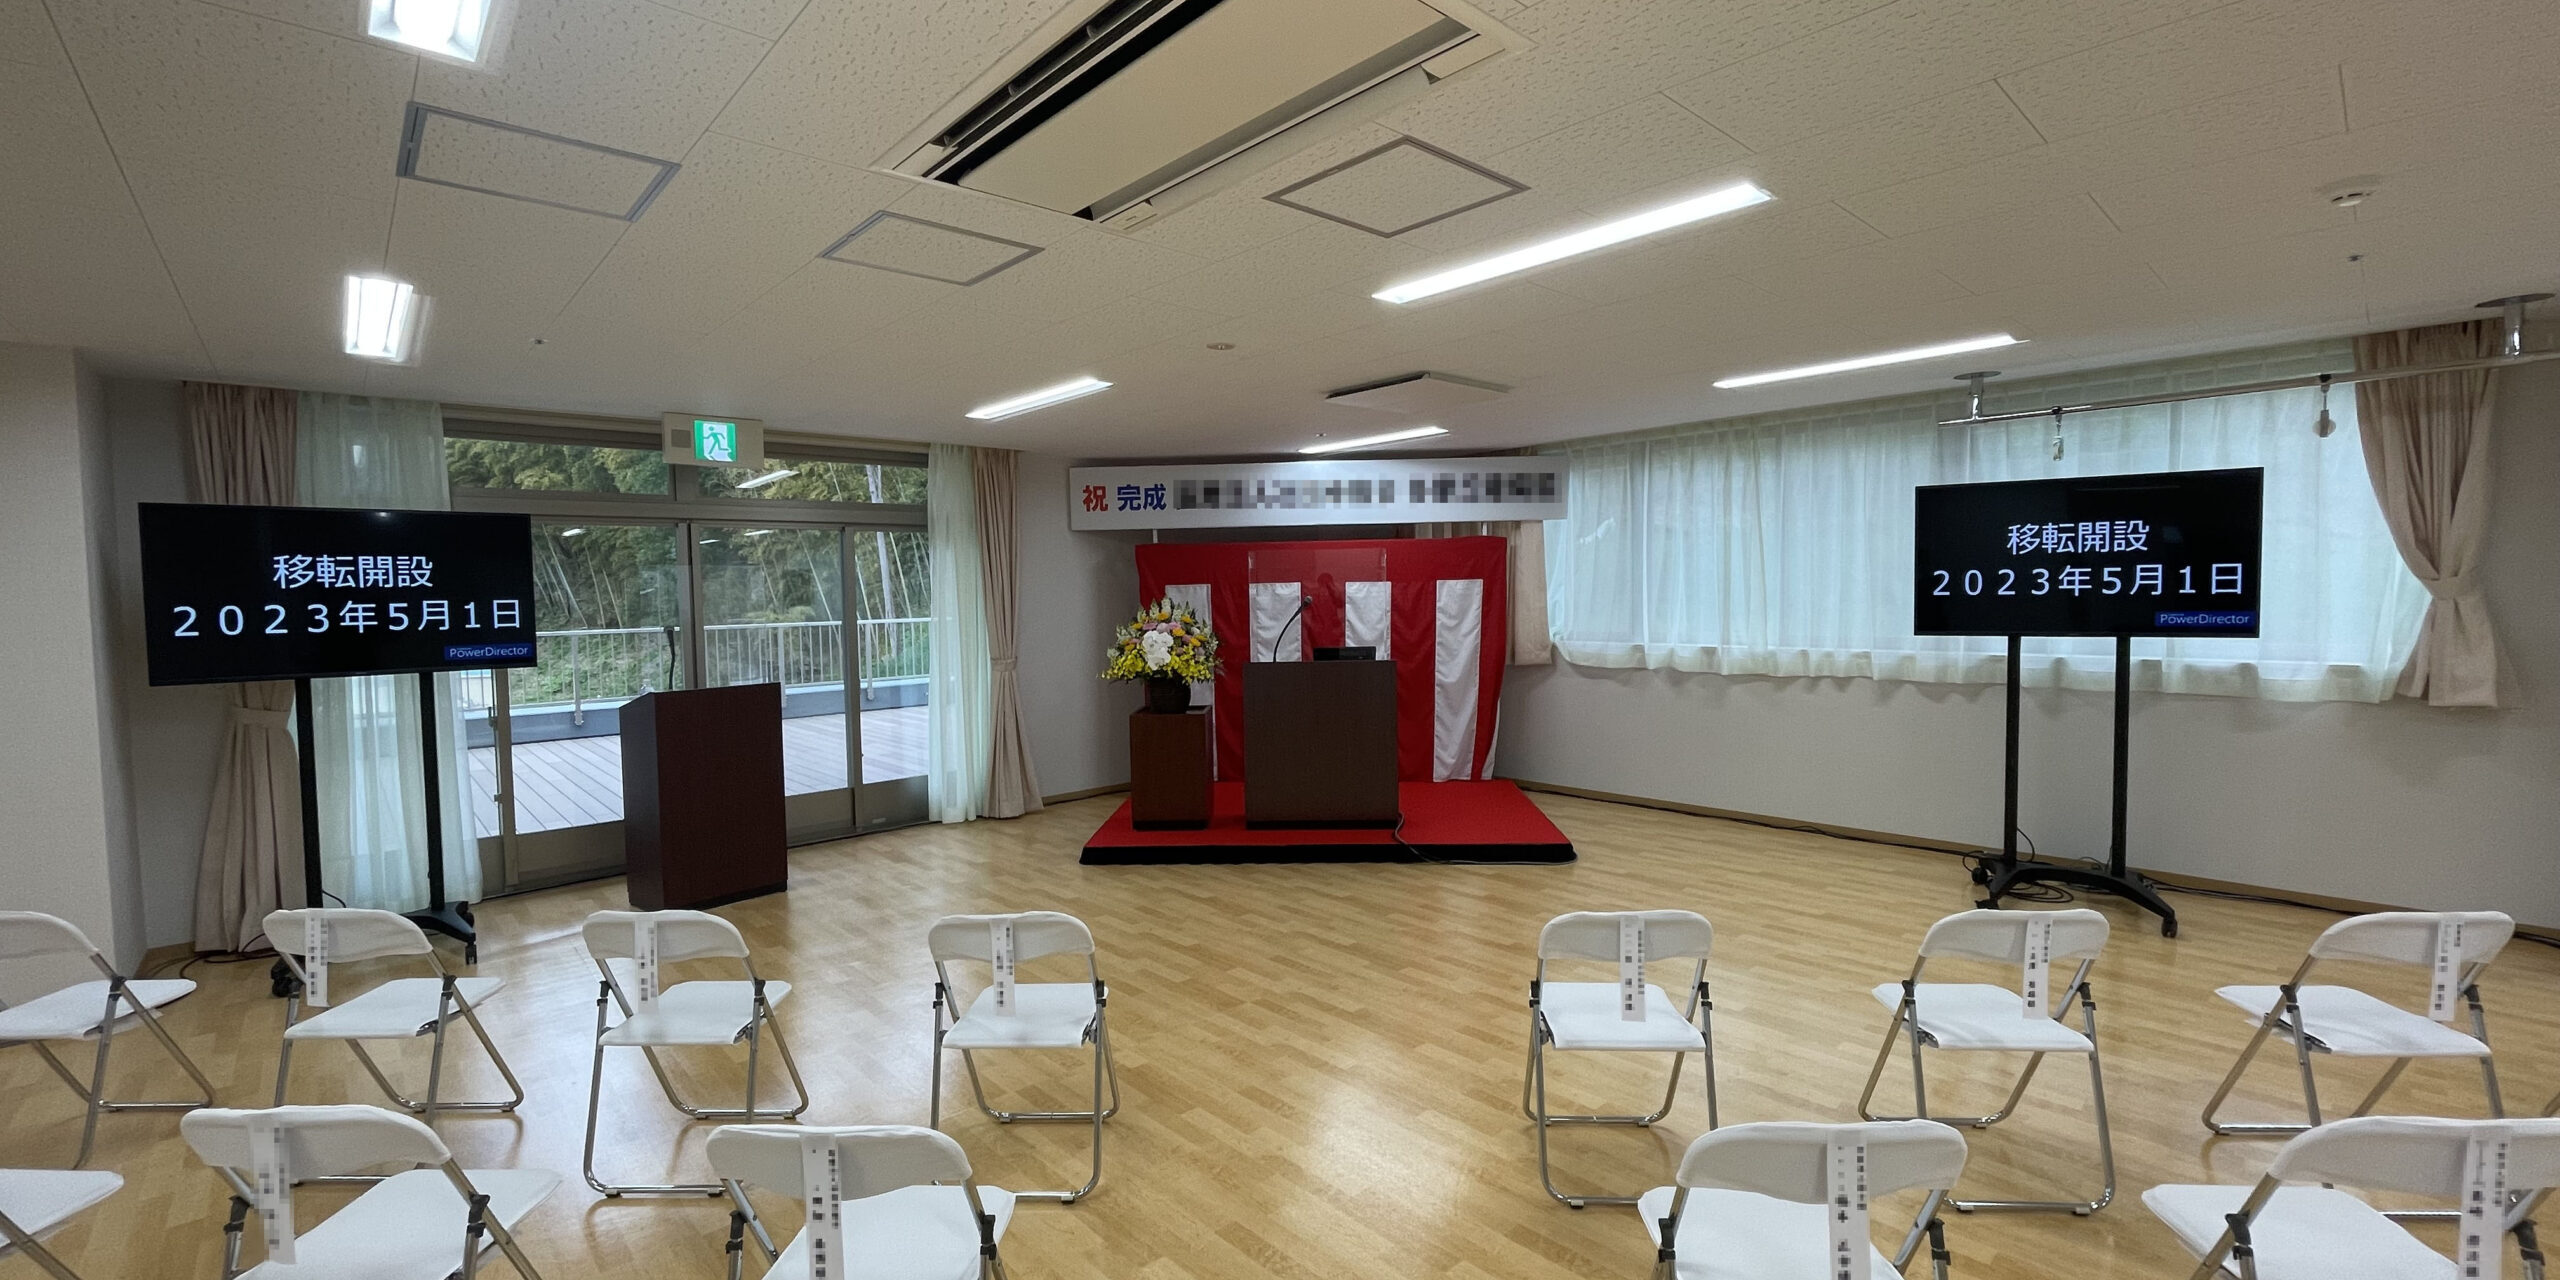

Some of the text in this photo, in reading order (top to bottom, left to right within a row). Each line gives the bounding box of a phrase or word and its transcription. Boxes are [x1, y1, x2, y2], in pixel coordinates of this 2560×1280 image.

[1082, 484, 1109, 512] 祝
[1117, 483, 1167, 512] 完成
[2006, 520, 2150, 556] 移転開設
[272, 554, 434, 590] 移転開設
[2160, 613, 2250, 624] PowerDirector
[449, 647, 529, 658] PowerDirector
